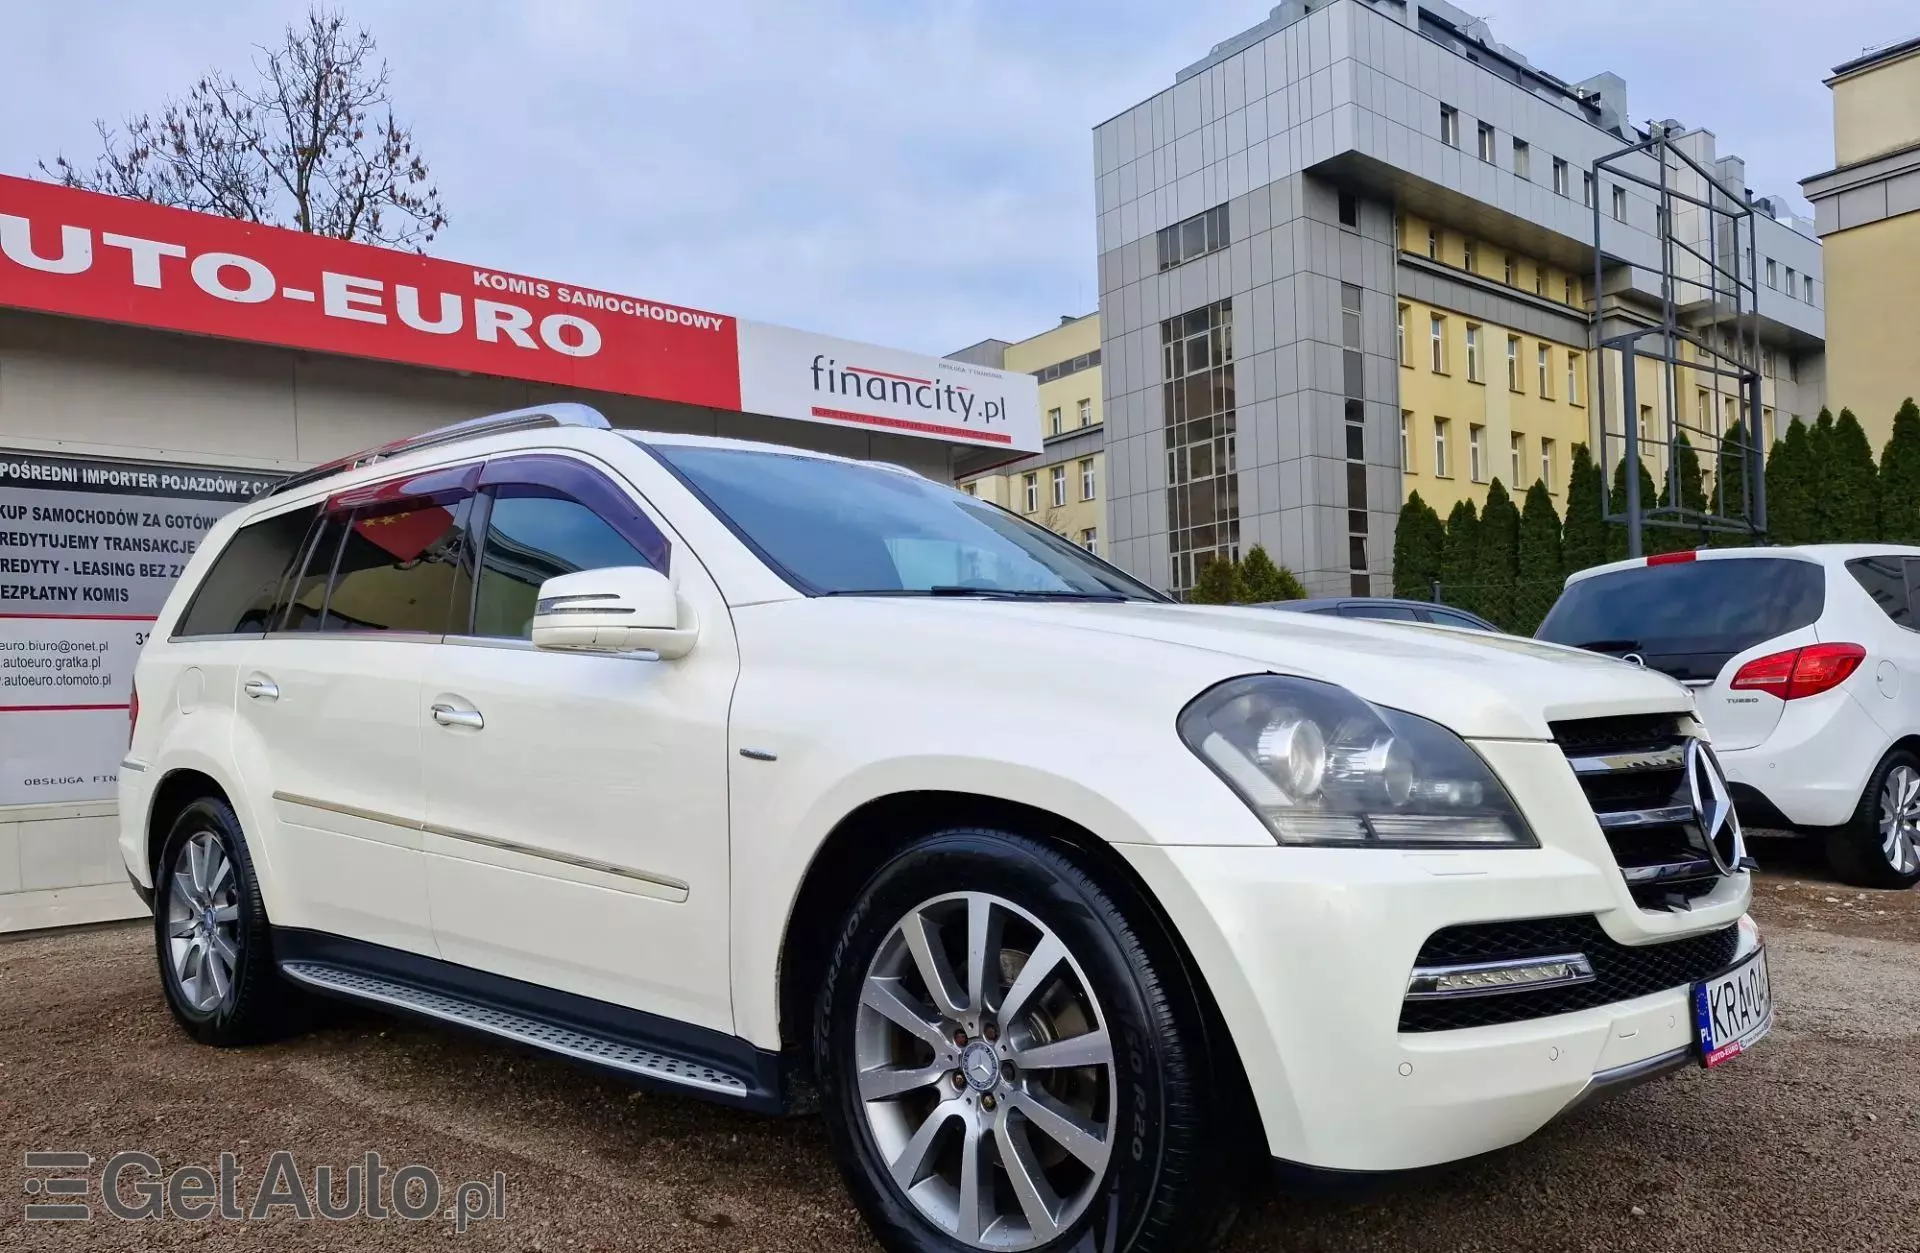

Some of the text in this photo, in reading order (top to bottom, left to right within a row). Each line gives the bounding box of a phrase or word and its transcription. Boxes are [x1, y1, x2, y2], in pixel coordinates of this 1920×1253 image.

[473, 271, 723, 332] KOMIS SAMOCHODOWY
[811, 355, 1006, 423] financity.pl
[0, 461, 78, 483] POŚREDNI
[82, 468, 158, 488] IMPORTER
[162, 475, 237, 494] POJAZDÓW
[240, 481, 250, 495] Z
[32, 507, 139, 527] SAMOCHODÓW
[142, 513, 161, 528] ZA
[165, 514, 218, 531] GOTÓW
[0, 532, 195, 554] REDYTUJEMY TRANSAKCJE
[0, 558, 60, 574] REDYTY
[73, 560, 135, 576] LEASING
[140, 563, 167, 578] BEZ
[0, 585, 129, 602] EZPŁATNY KOMIS
[24, 776, 84, 786] OBSŁUGA
[1700, 1027, 1711, 1044] PL
